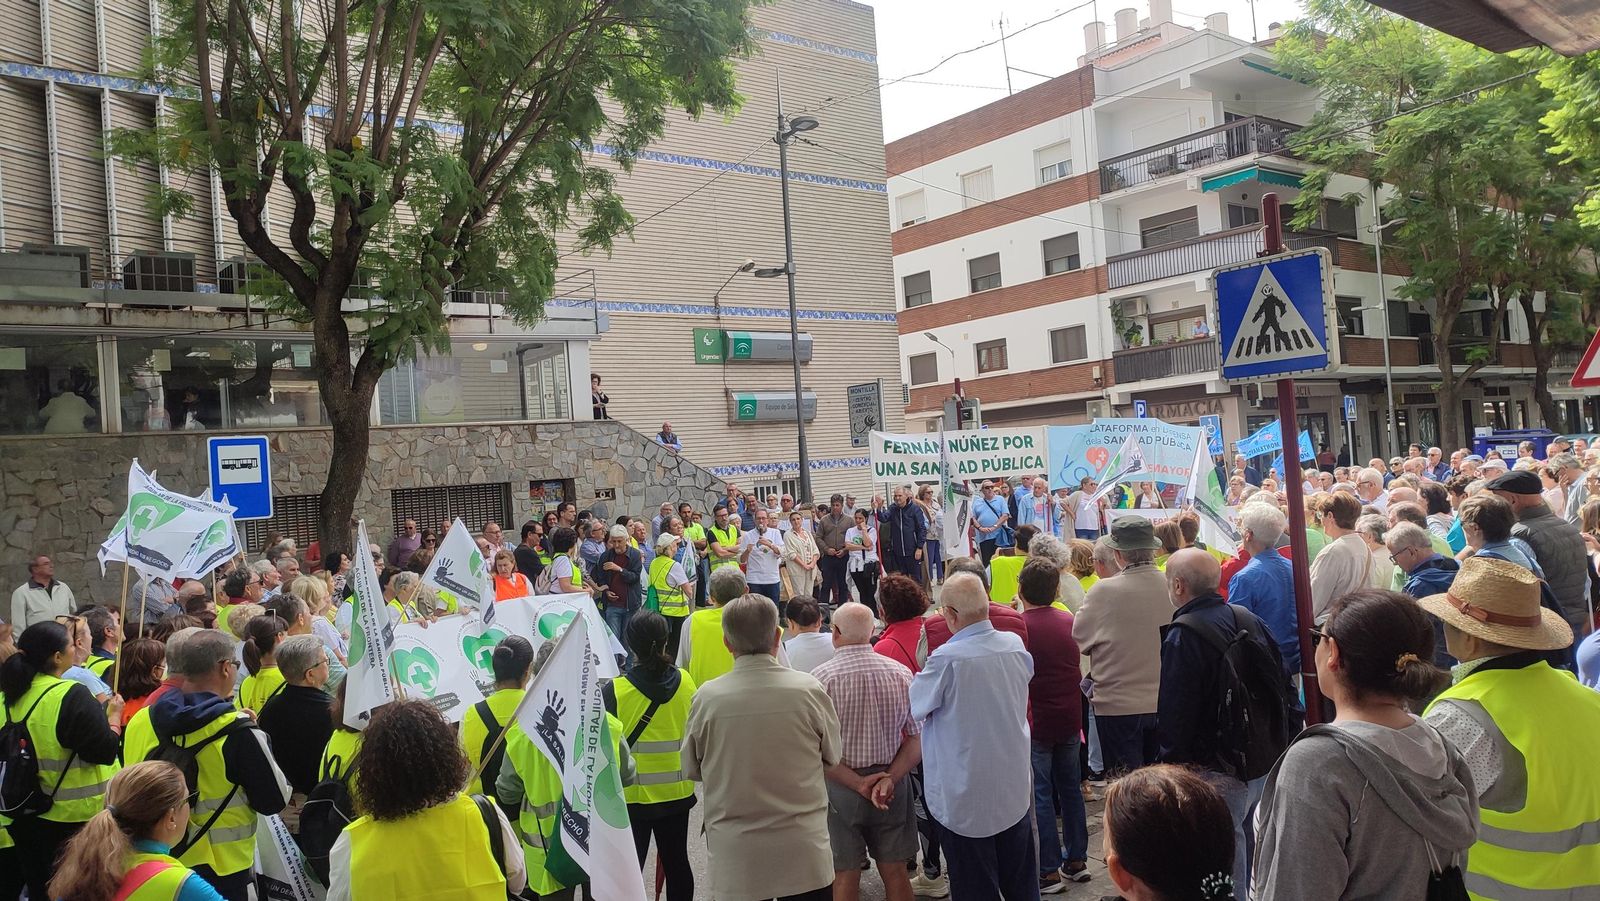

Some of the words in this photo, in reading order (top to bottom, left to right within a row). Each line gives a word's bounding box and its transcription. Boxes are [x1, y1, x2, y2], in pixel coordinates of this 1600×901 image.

[1146, 399, 1225, 419] ARMACIA
[1090, 424, 1148, 433] ATAFORMA
[884, 438, 940, 454] FERNÁN
[948, 434, 999, 453] NÚÑEZ
[1003, 434, 1033, 449] POR
[1104, 436, 1153, 445] SANAD
[875, 461, 907, 476] UNA
[911, 459, 978, 475] SANAD
[981, 454, 1044, 473] PÚBLICA
[355, 567, 364, 602] AGUILAR
[360, 602, 368, 613] DE
[362, 614, 369, 626] LA
[365, 626, 376, 669] FRONTERA
[375, 639, 384, 668] SANIDAD
[552, 741, 565, 763] SALU
[561, 807, 584, 839] RECHO,
